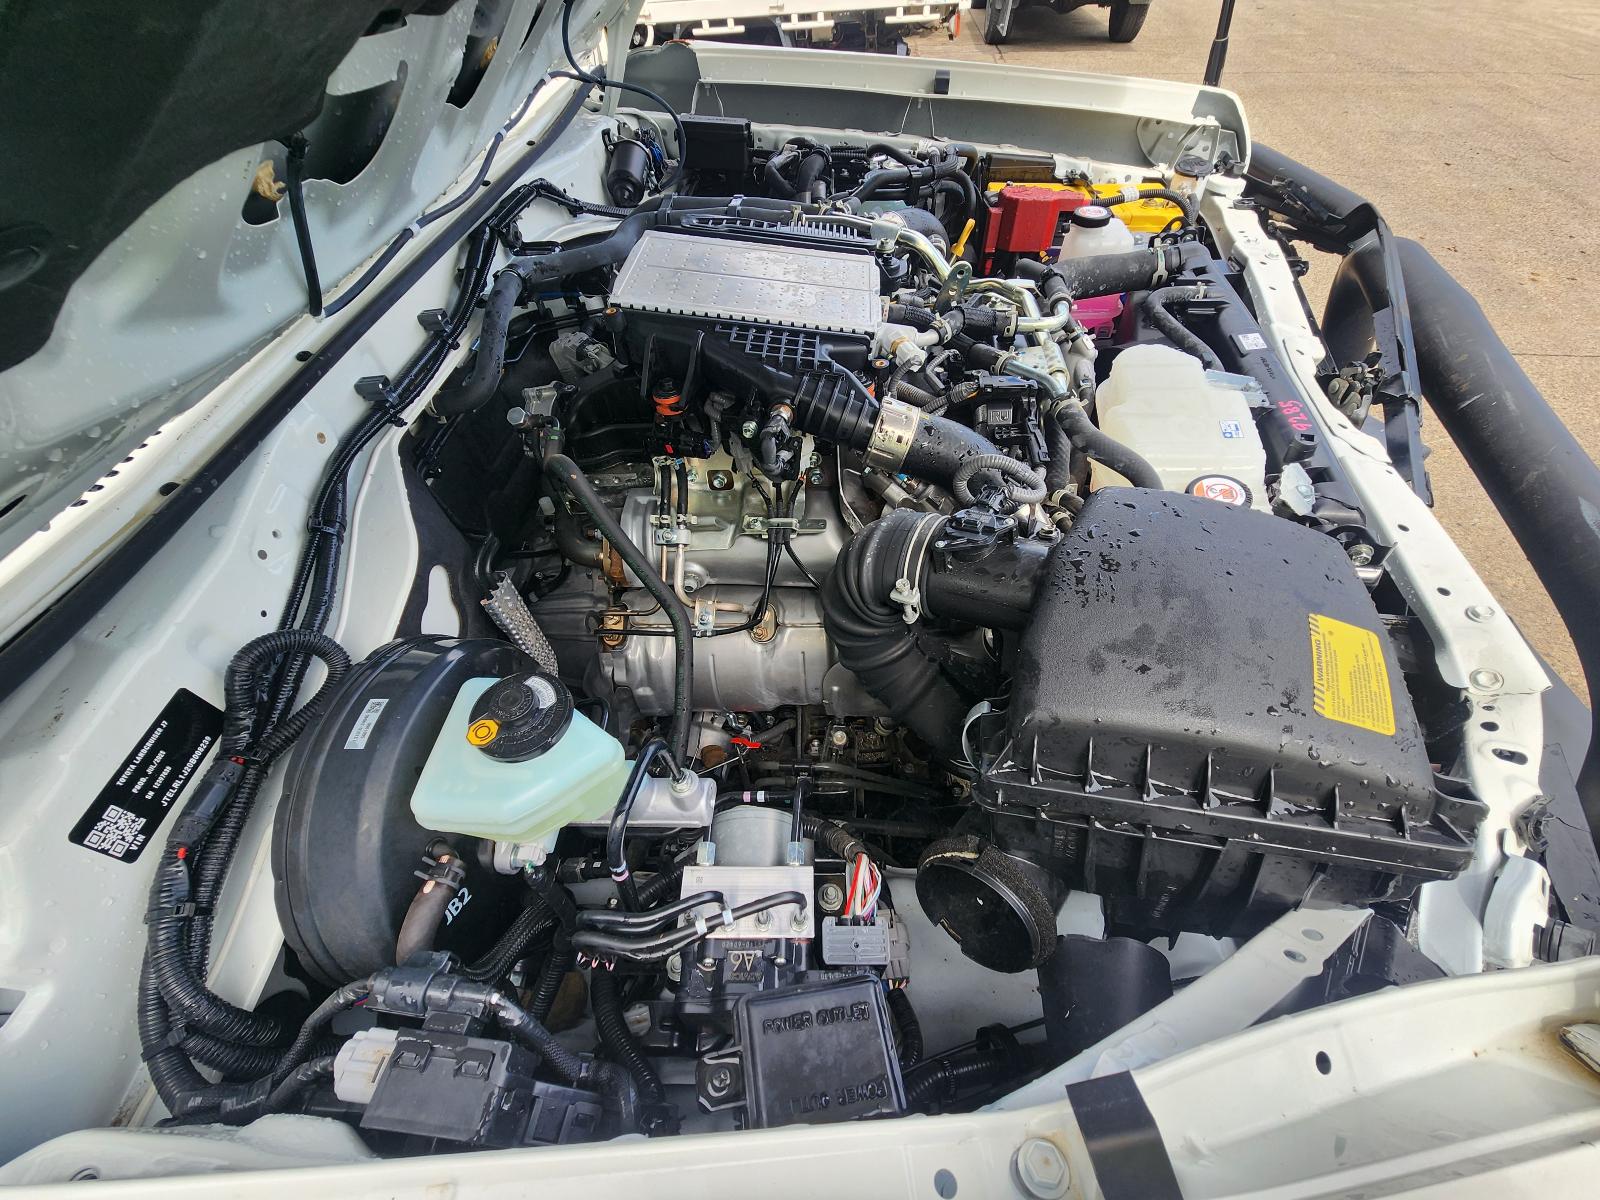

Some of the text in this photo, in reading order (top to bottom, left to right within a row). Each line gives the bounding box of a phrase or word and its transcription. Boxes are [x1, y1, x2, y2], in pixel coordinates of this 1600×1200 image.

[1315, 640, 1325, 682] WARNING
[116, 720, 168, 786] TOYOTA LANDCRUISER J7
[132, 776, 149, 794] PROD.
[161, 735, 212, 807] JTELRL1J20B008239
[145, 790, 155, 800] SN
[130, 833, 146, 851] VIN
[445, 887, 473, 926] JB2
[731, 952, 755, 972] A6
[763, 1001, 870, 1035] POWER OUTLET
